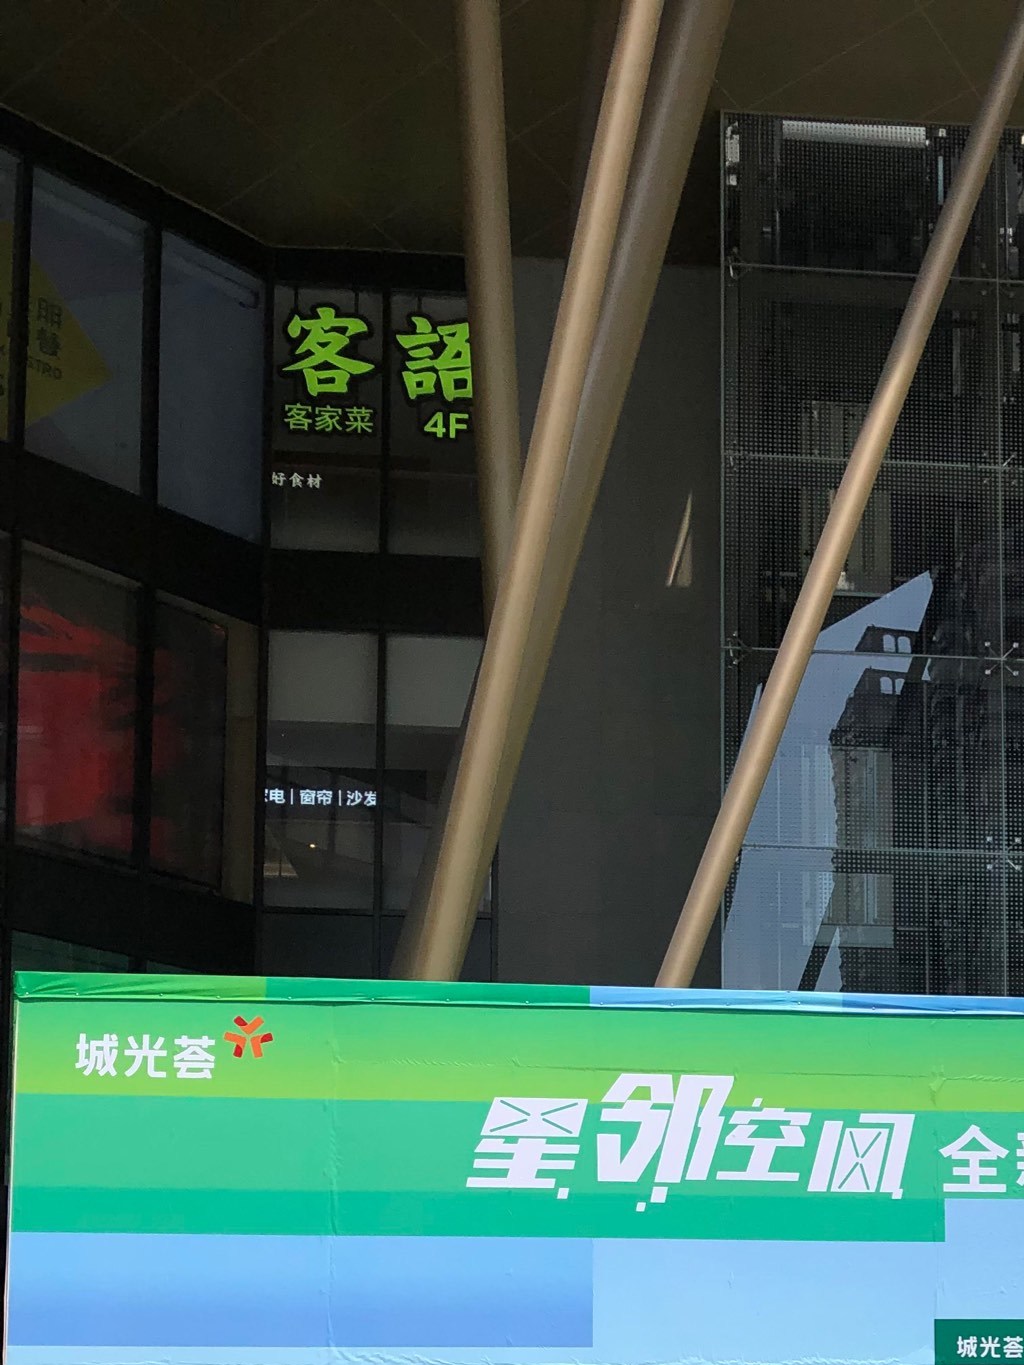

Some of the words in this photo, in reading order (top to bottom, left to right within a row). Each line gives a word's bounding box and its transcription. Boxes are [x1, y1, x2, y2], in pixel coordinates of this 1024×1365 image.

[284, 403, 374, 433] 客家菜
[424, 411, 469, 438] 4F
[75, 1033, 217, 1079] 城光荟
[956, 1335, 1024, 1359] 城光荟
